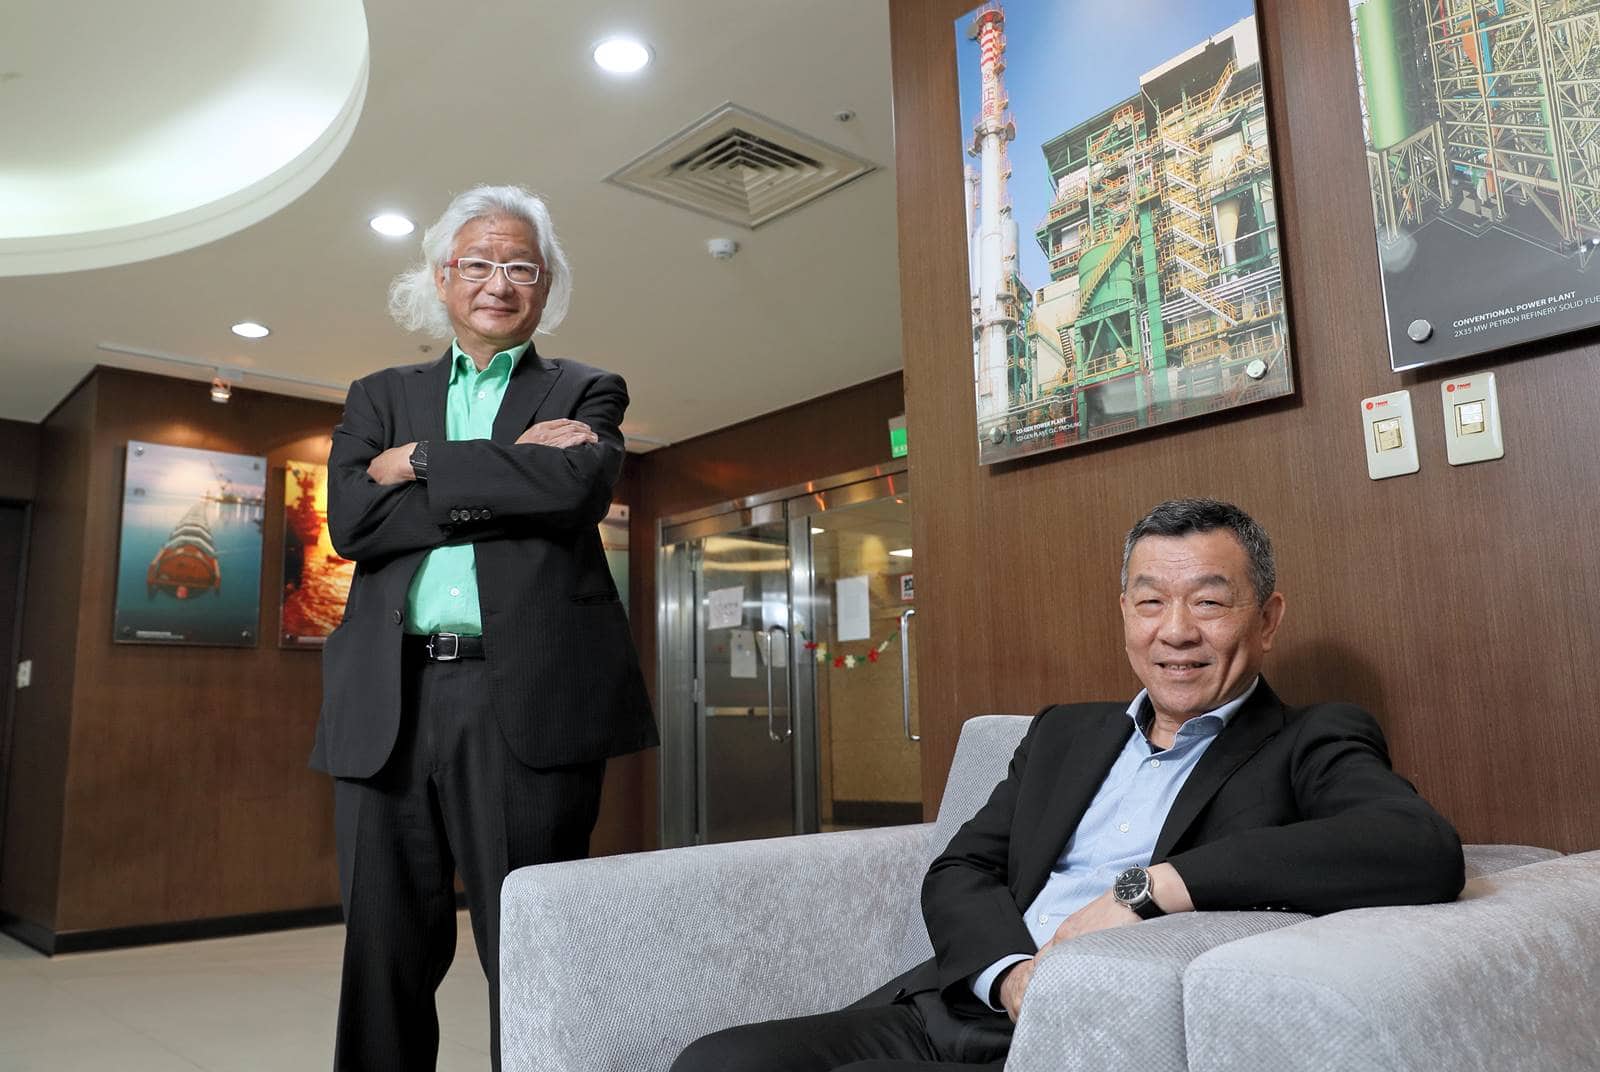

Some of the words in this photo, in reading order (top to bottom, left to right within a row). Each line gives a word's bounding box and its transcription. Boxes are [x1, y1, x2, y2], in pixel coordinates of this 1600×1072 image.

[1453, 307, 1515, 328] CONVENTIONAL
[1516, 299, 1547, 312] POWER
[1548, 291, 1576, 304] PLANT
[1454, 328, 1472, 338] 2X35
[1473, 323, 1488, 333] MW
[1489, 315, 1520, 329] PETRON
[1521, 306, 1558, 321] REFINERY
[1558, 299, 1583, 312] SOLID
[1016, 424, 1034, 435] CO-GEN
[1034, 421, 1050, 432] POWER
[1051, 418, 1067, 427] PLANT
